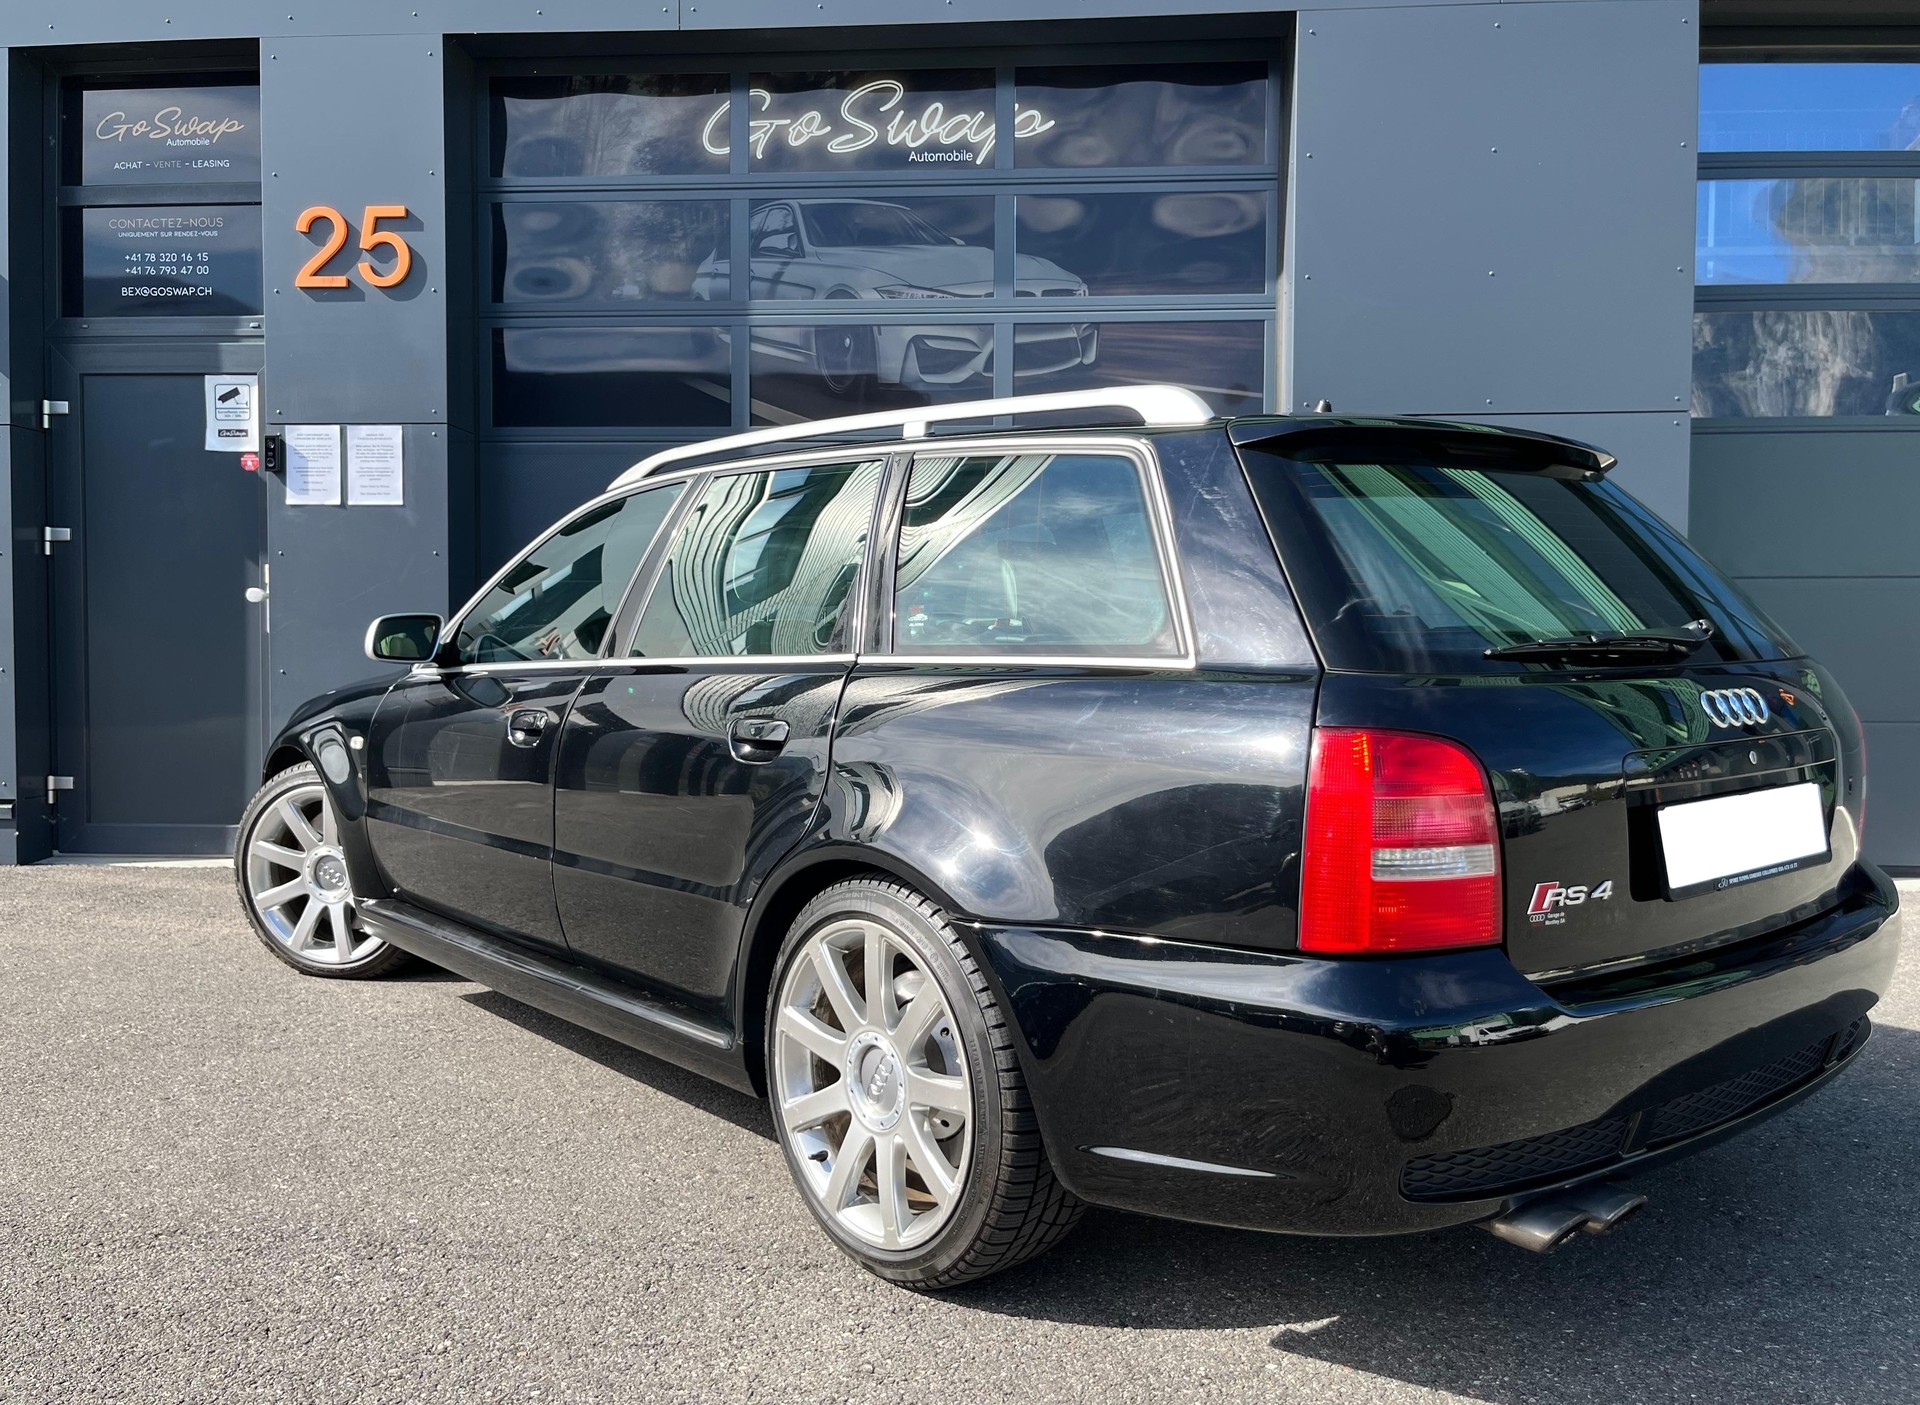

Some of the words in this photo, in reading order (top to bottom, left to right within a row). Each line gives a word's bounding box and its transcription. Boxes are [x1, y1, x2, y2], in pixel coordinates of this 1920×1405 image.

[166, 138, 210, 147] Automobile
[908, 149, 973, 163] Automobile
[113, 161, 143, 170] ACHAT
[153, 160, 182, 169] VENTE
[192, 159, 230, 168] LEASING
[108, 217, 224, 229] CONTACTEZ-NOUS
[294, 205, 412, 288] 25
[124, 253, 142, 262] +41
[144, 253, 156, 262] 78
[159, 253, 177, 262] 320
[181, 252, 193, 262] 16
[197, 252, 209, 262] 15
[124, 266, 142, 275] +41
[144, 266, 156, 275] 76
[159, 266, 177, 275] 793
[180, 266, 193, 275] 47
[196, 265, 209, 275] 00
[121, 287, 213, 297] BEX@GOSWAP.CH
[1590, 880, 1613, 901] 4
